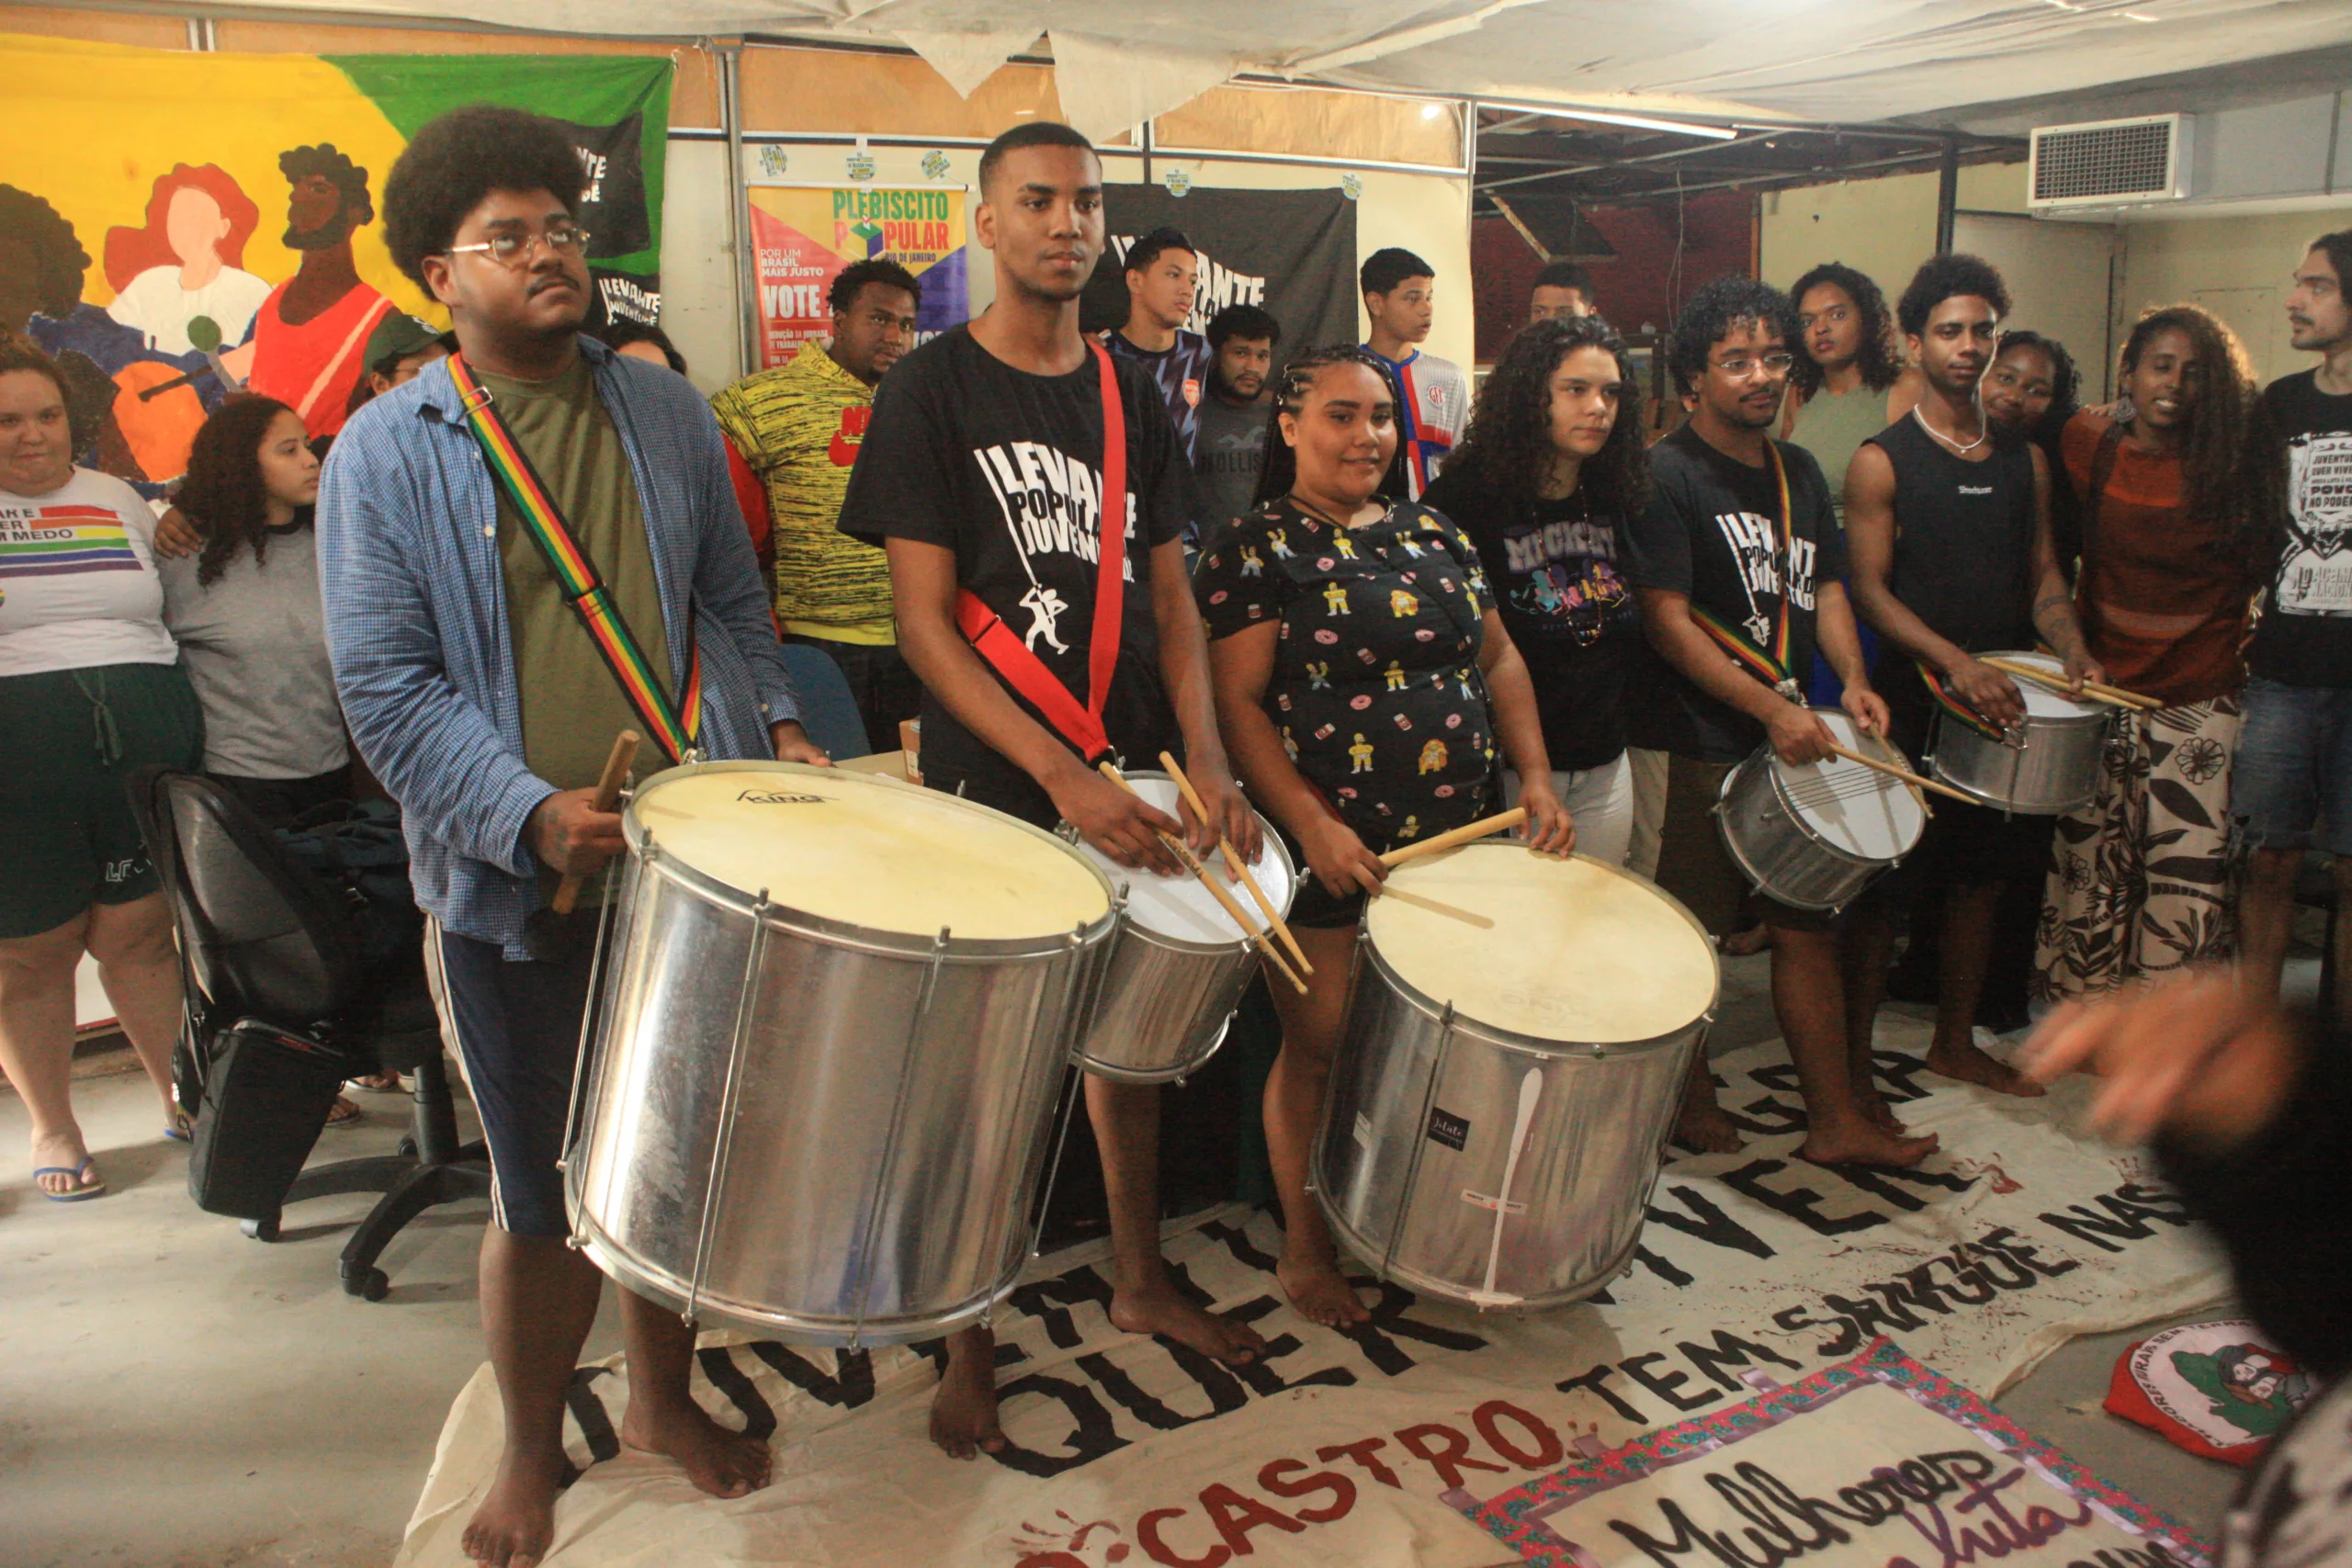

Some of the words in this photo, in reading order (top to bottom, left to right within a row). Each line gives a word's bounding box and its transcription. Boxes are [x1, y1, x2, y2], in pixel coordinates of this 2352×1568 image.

[832, 190, 949, 220] PLEBISCITO
[760, 248, 781, 258] POR
[784, 248, 801, 258] UM
[761, 258, 798, 267] BRASIL
[899, 254, 908, 263] DE
[910, 254, 936, 264] JANEIRO
[762, 267, 787, 277] MAIS
[790, 267, 824, 277] JUSTO
[763, 285, 821, 319] VOTE
[2312, 467, 2332, 476] QUER
[2309, 498, 2322, 508] NO
[12, 528, 74, 541] MEDO
[1503, 521, 1618, 571] MICKEY
[987, 1275, 1490, 1478] QUER
[1137, 1400, 1564, 1568] CASTRO
[1555, 1329, 1803, 1426] TEM
[1772, 1226, 2082, 1358] SANGUE
[2037, 1182, 2196, 1253] NAS
